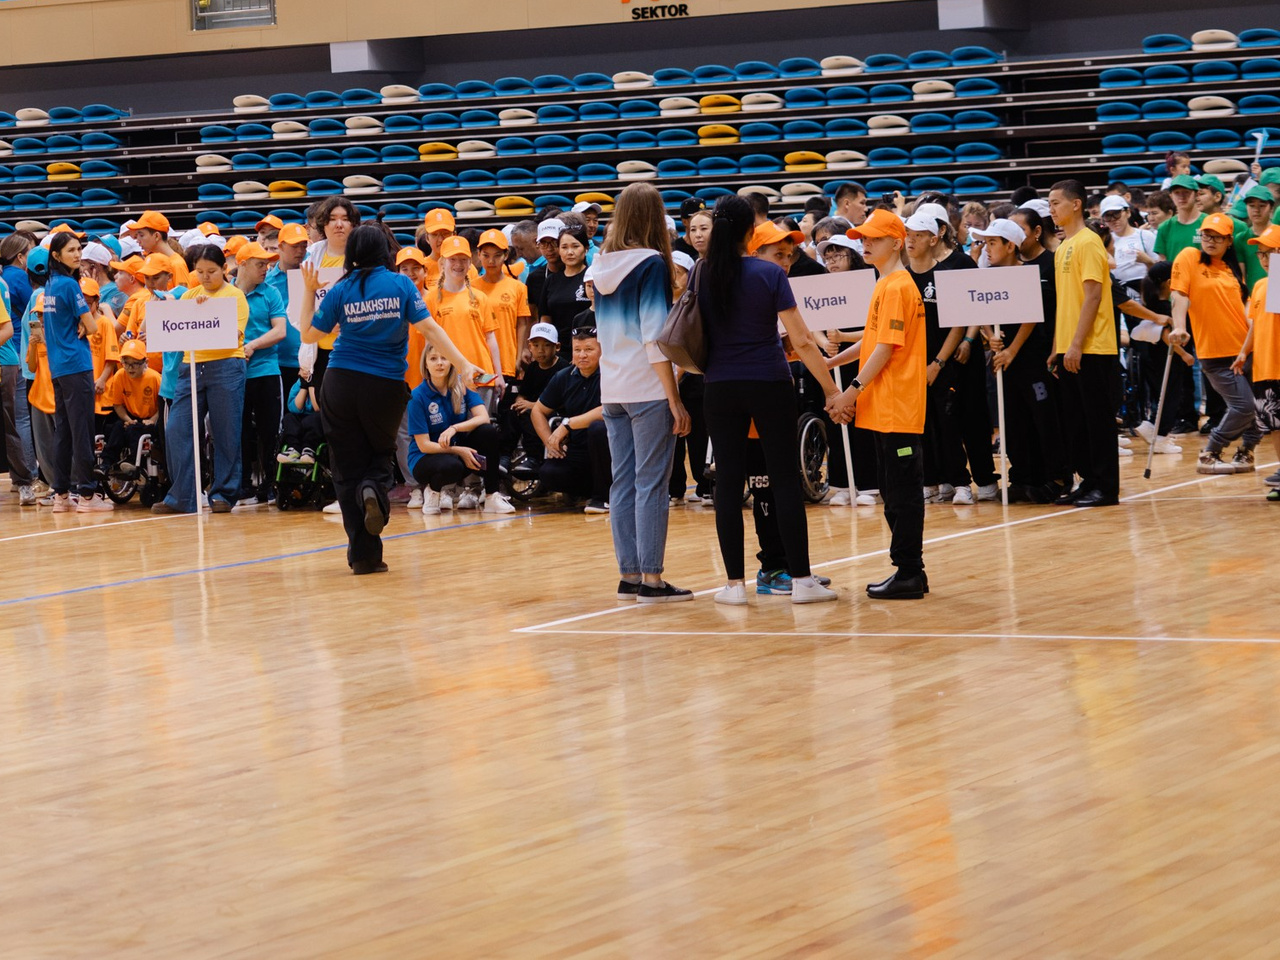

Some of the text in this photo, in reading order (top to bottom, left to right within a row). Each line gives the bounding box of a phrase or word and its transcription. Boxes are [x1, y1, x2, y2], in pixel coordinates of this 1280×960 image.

[631, 3, 690, 20] SEKTOR
[803, 295, 848, 311] Құлан
[967, 289, 1010, 304] Тараз
[344, 297, 400, 316] KAZAKHSTAN
[162, 316, 221, 333] Қостанай
